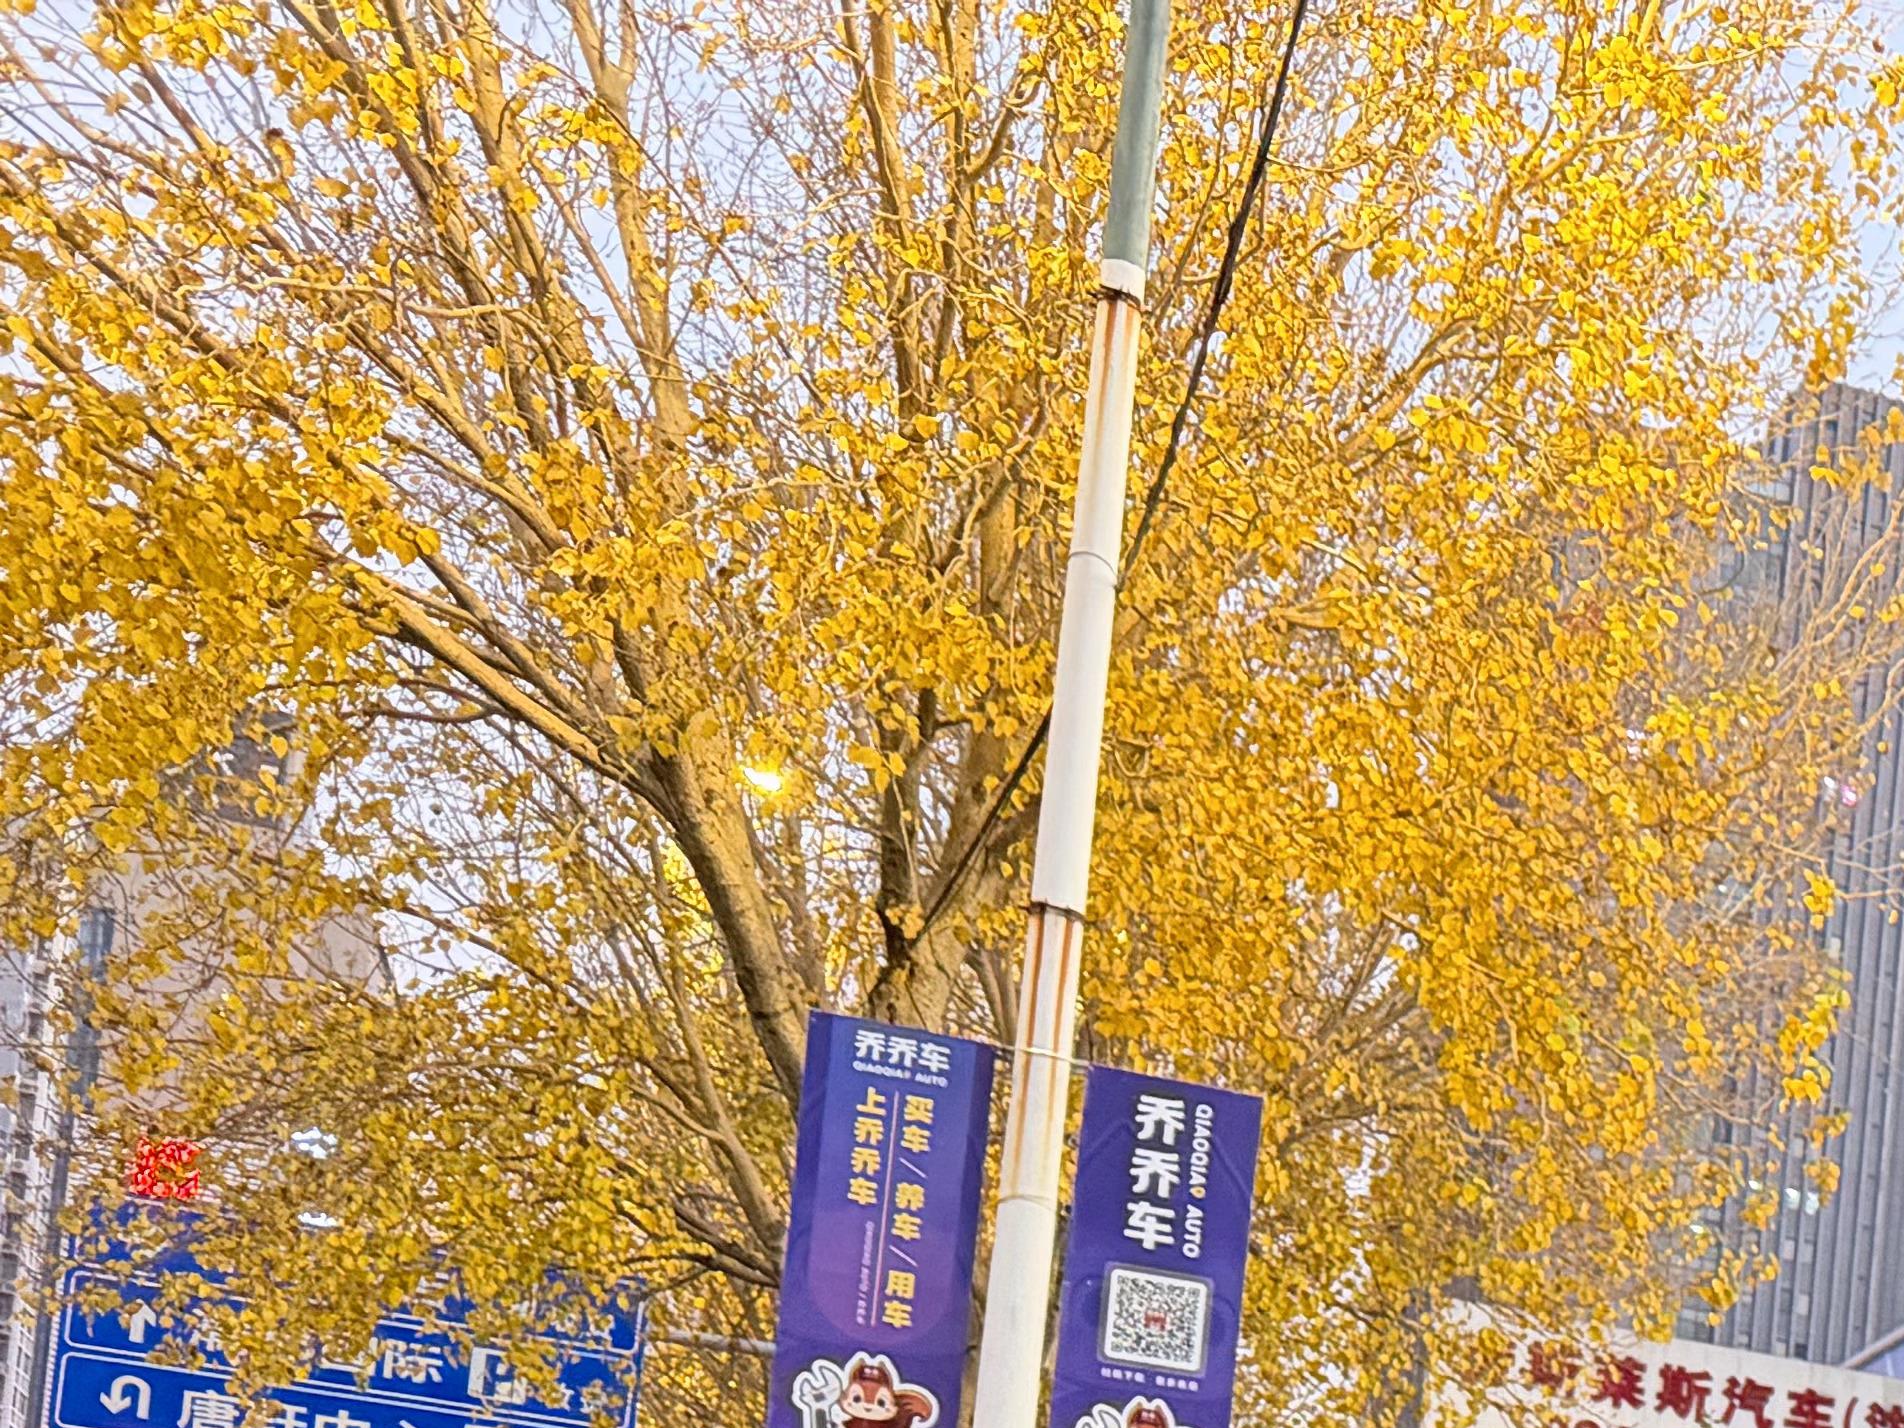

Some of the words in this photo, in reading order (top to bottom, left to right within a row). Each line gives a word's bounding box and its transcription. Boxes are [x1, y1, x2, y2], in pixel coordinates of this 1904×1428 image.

[854, 1029, 951, 1072] 乔乔车
[847, 1086, 886, 1205] 上乔乔车
[1123, 1094, 1186, 1250] 乔乔车
[1182, 1204, 1204, 1258] AUTO
